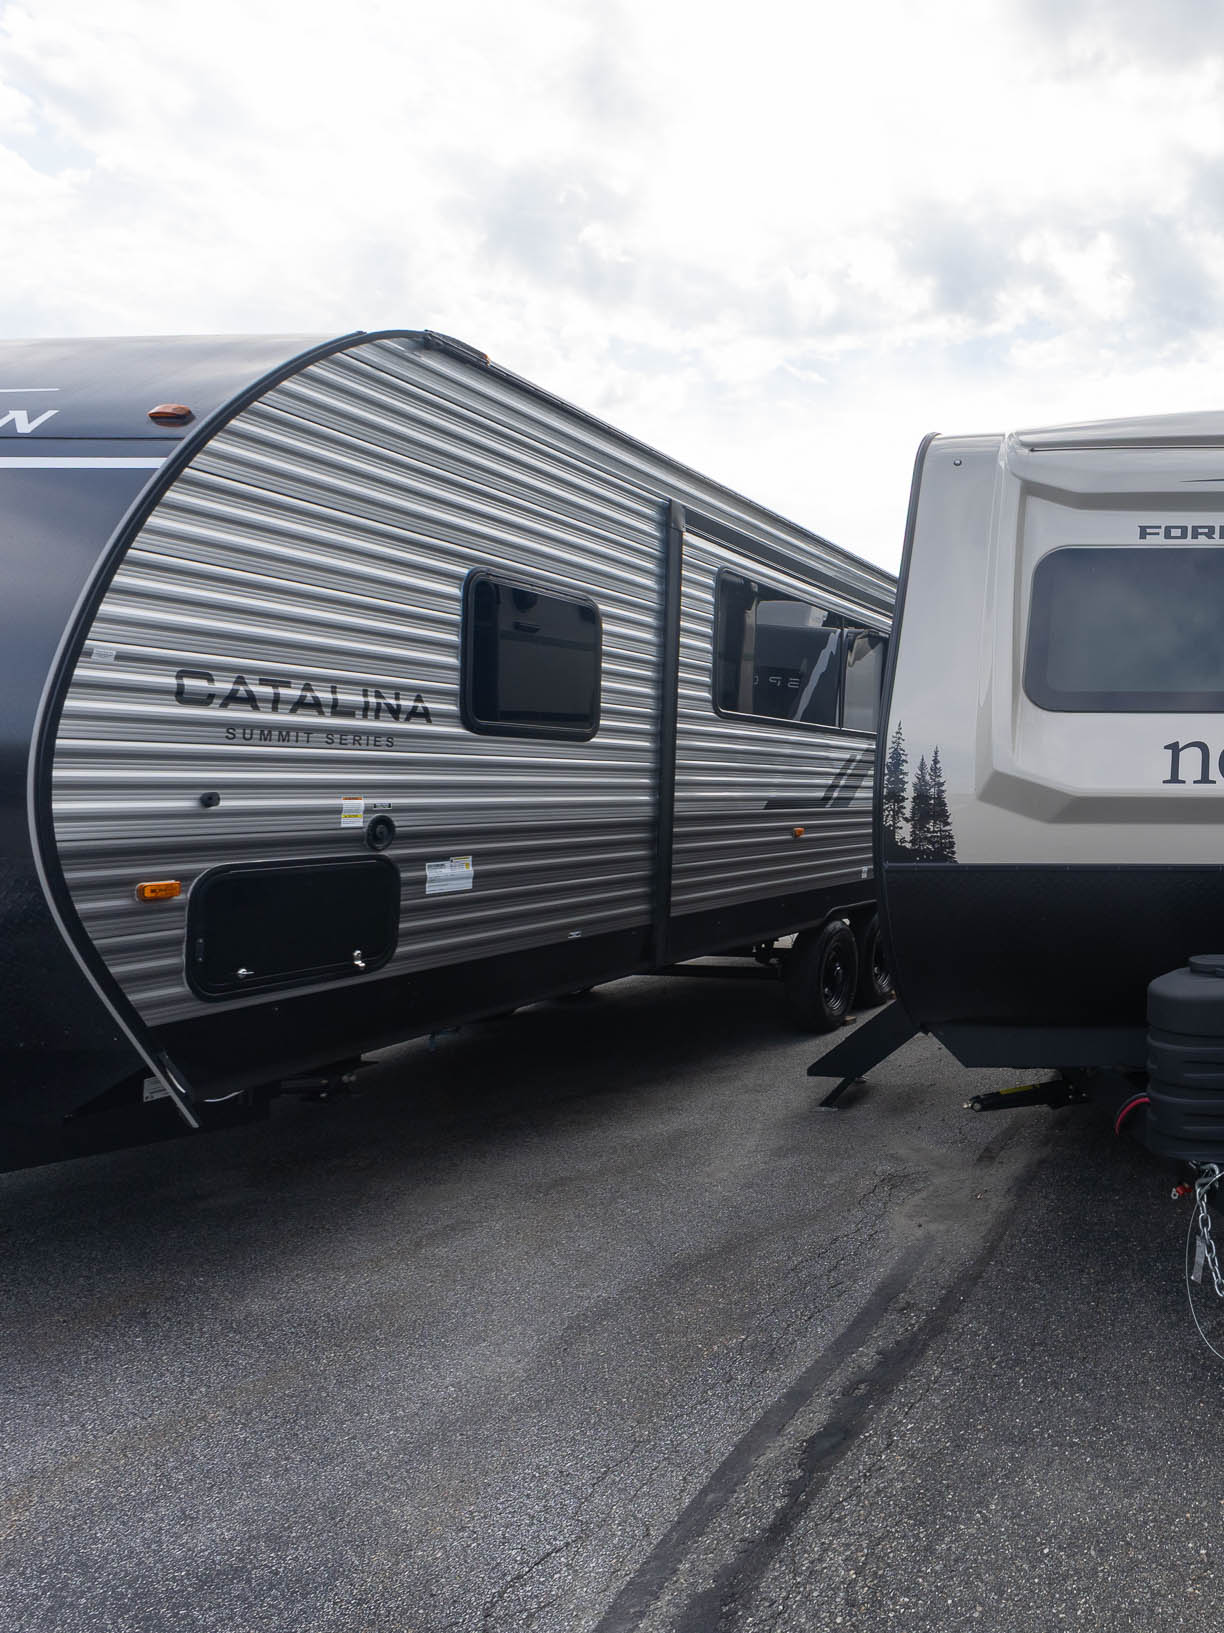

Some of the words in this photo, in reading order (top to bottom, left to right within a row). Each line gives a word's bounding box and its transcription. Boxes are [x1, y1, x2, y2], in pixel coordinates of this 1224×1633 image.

[174, 669, 432, 723] CATALINA
[225, 727, 314, 744] SUMMIT
[325, 733, 395, 748] SERIES
